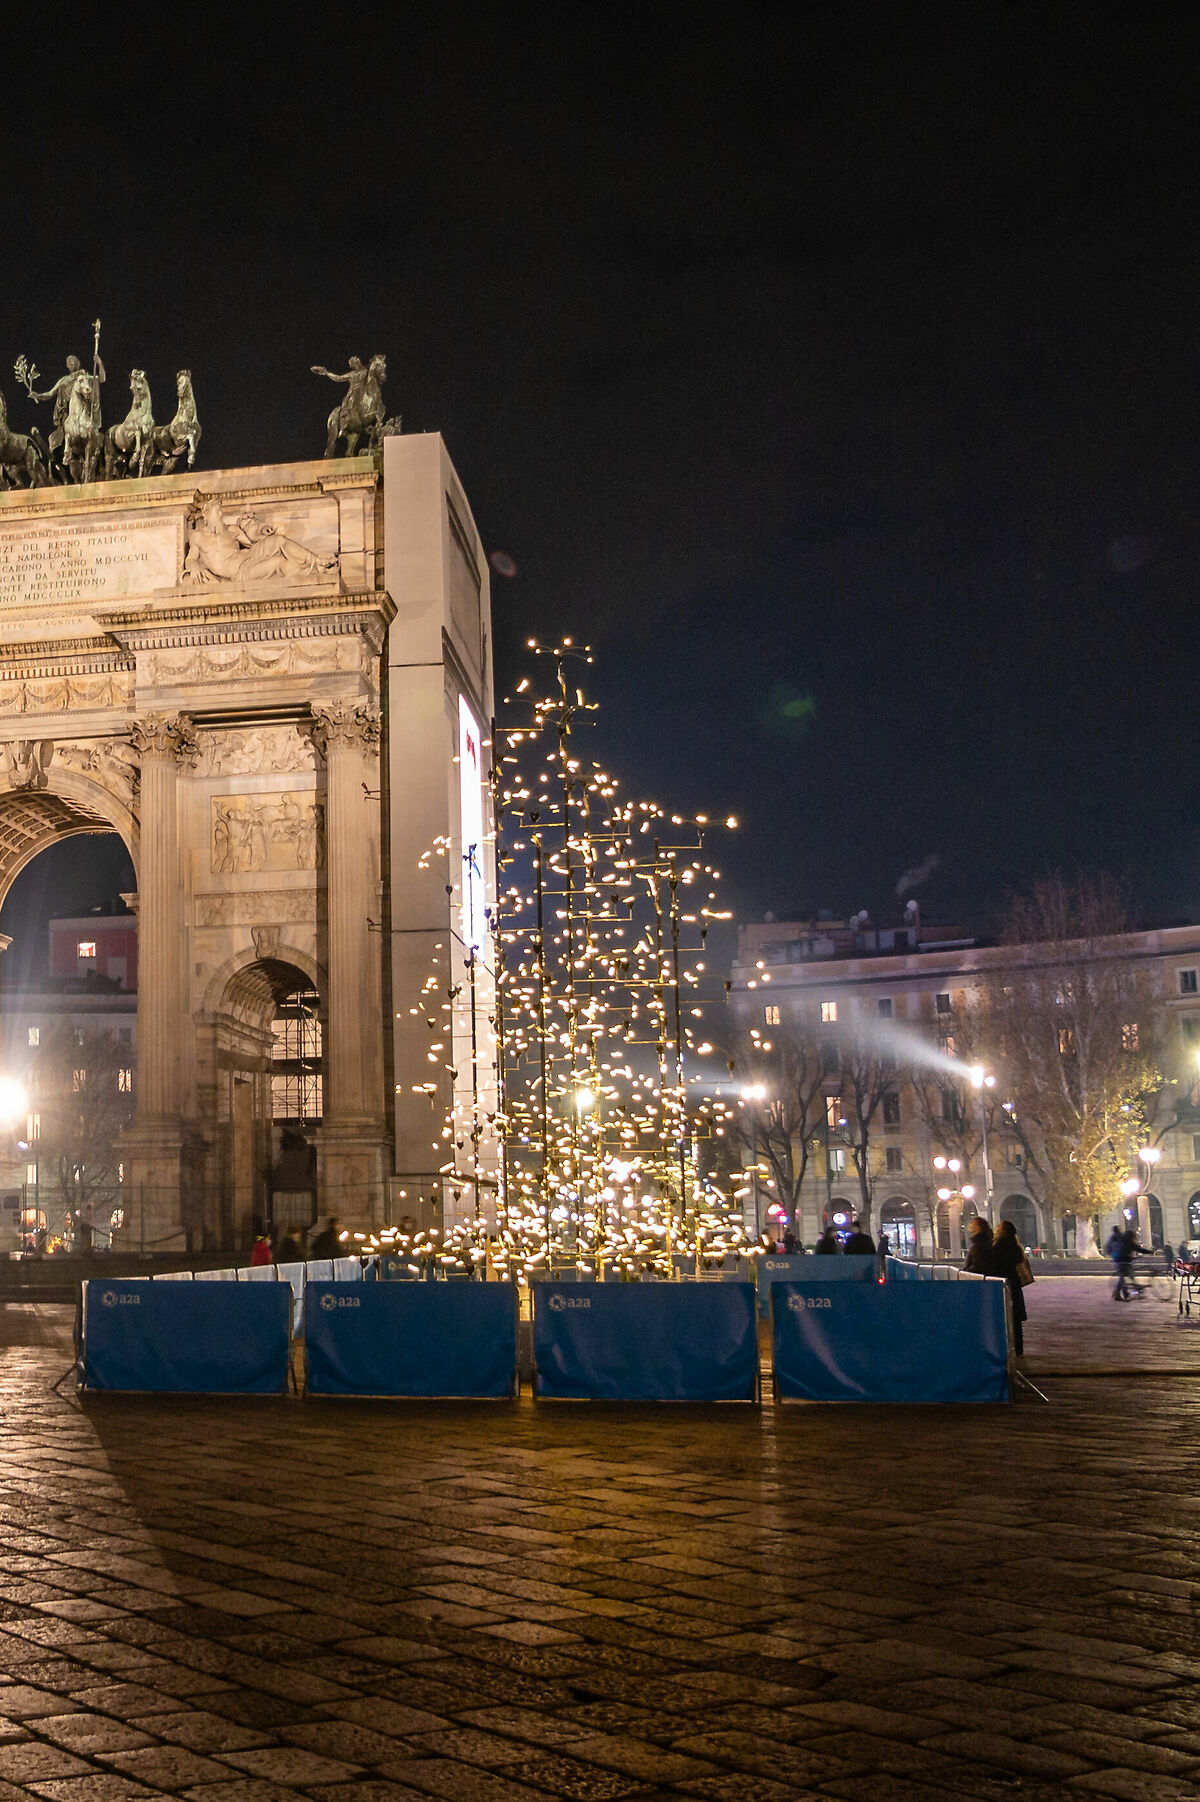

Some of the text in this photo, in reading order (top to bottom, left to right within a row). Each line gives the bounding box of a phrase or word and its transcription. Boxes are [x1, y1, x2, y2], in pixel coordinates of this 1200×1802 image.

[22, 543, 39, 551] DEL
[48, 539, 80, 549] REGNO
[88, 535, 127, 546] ITALICO
[17, 550, 72, 561] NAPOLEONE
[35, 572, 48, 580] DA
[30, 577, 106, 591] RESTITUIRONO
[23, 589, 81, 601] MDCCCLIX
[119, 1294, 140, 1304] a2a
[338, 1296, 360, 1307] a2a
[567, 1297, 591, 1308] a2a
[807, 1297, 832, 1308] a2a
